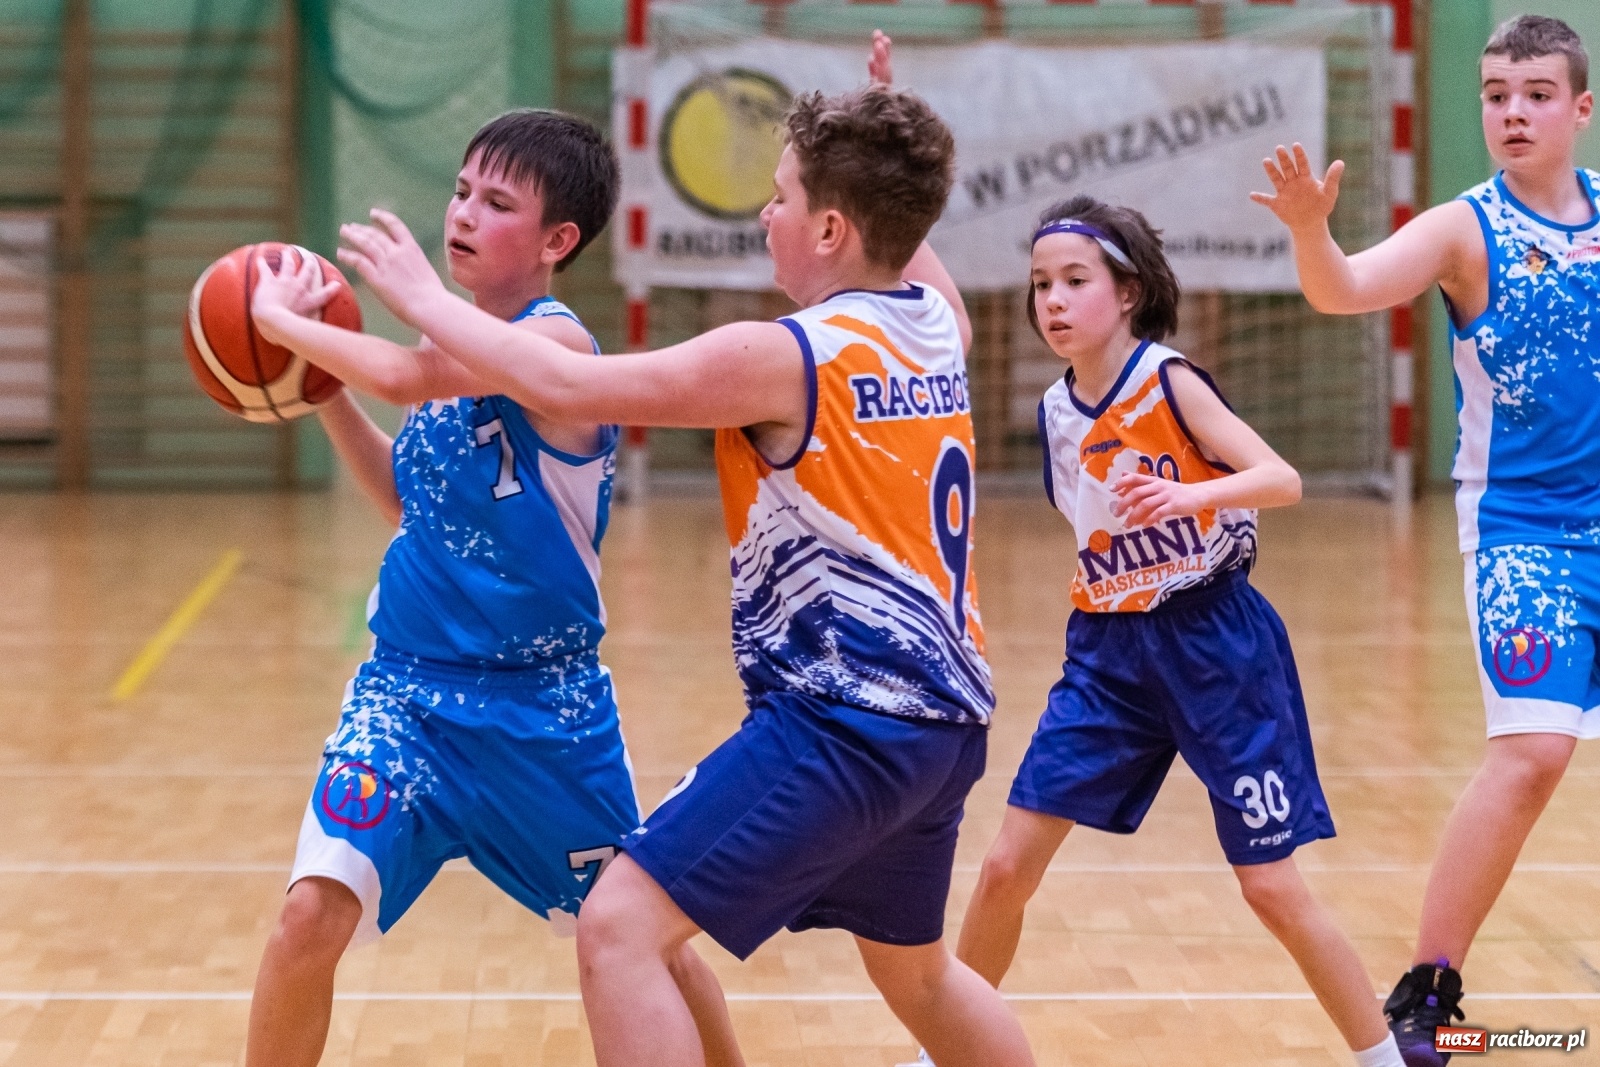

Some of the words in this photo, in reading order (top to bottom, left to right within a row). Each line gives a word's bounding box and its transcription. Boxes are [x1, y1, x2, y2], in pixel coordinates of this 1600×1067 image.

[475, 417, 524, 501] 7
[932, 442, 971, 641] 9
[1078, 515, 1206, 586] MINI
[1090, 555, 1208, 600] BASKETBALL
[1233, 769, 1291, 829] 30
